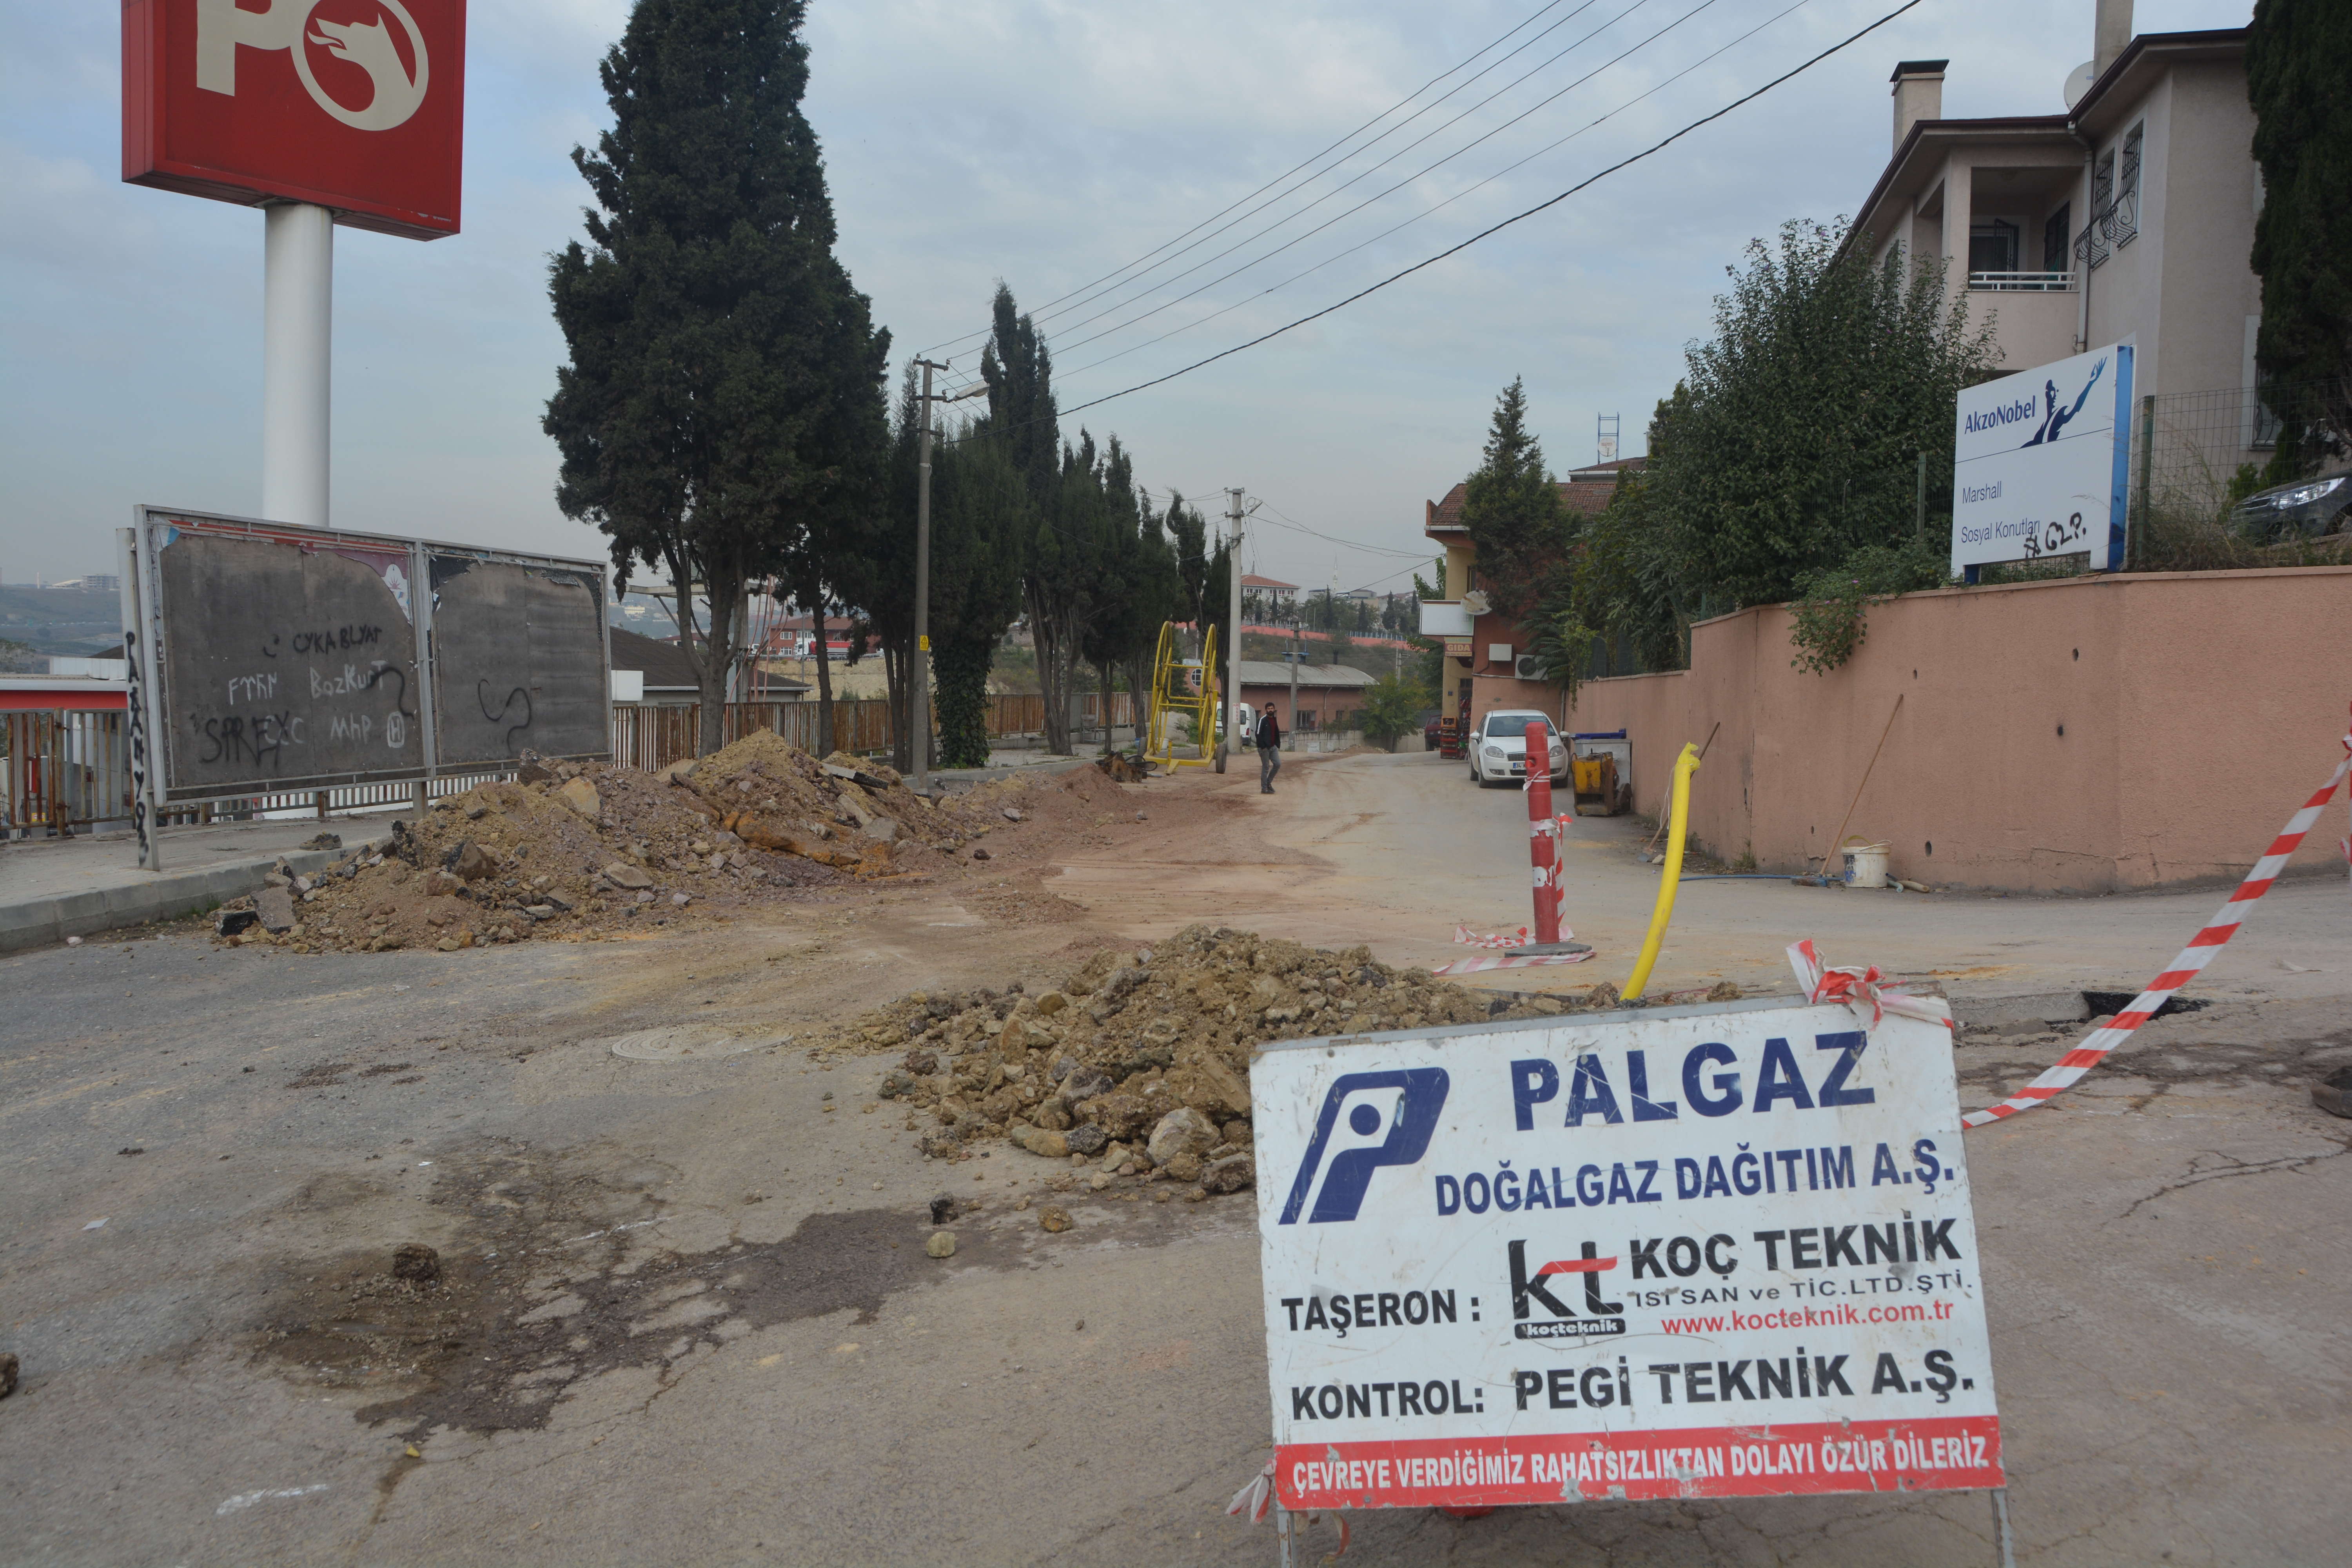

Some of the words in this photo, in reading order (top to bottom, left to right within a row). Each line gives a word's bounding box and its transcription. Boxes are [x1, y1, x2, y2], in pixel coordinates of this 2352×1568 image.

[1964, 395, 2036, 434] AkzoNobel
[1962, 481, 2002, 504] Marshall
[1961, 523, 1992, 545] Sosyal
[1995, 517, 2040, 539] Konutları
[1510, 1031, 1876, 1131] PALGAZ
[1435, 1160, 1662, 1216] DOĞALGAZ
[1675, 1142, 1856, 1200] DAĞITIM
[1872, 1138, 1954, 1195] A.Ş.
[1630, 1233, 1739, 1279] KOÇ
[1754, 1210, 1963, 1271] TEKNİK
[1681, 1287, 1739, 1305] SAN
[1749, 1286, 1780, 1301] ve
[1526, 1319, 1618, 1338] koçteknik
[1661, 1299, 1954, 1334] www.kocteknik.com.tr
[1291, 1379, 1484, 1421] KONTROL:
[1515, 1355, 1631, 1411] PEGİ
[1648, 1346, 1855, 1404] TEKNİK
[1871, 1349, 1974, 1403] A.Ş.
[1293, 1459, 1390, 1499] ÇEVREYE
[1396, 1448, 1524, 1487] VERDİĞİMİZ
[1532, 1446, 1724, 1483] RAHATSIZLIKTAN
[1732, 1442, 1815, 1476] DOLAYI
[1821, 1434, 1888, 1473] ÖZÜR
[1893, 1430, 1989, 1470] DİLERİZ
